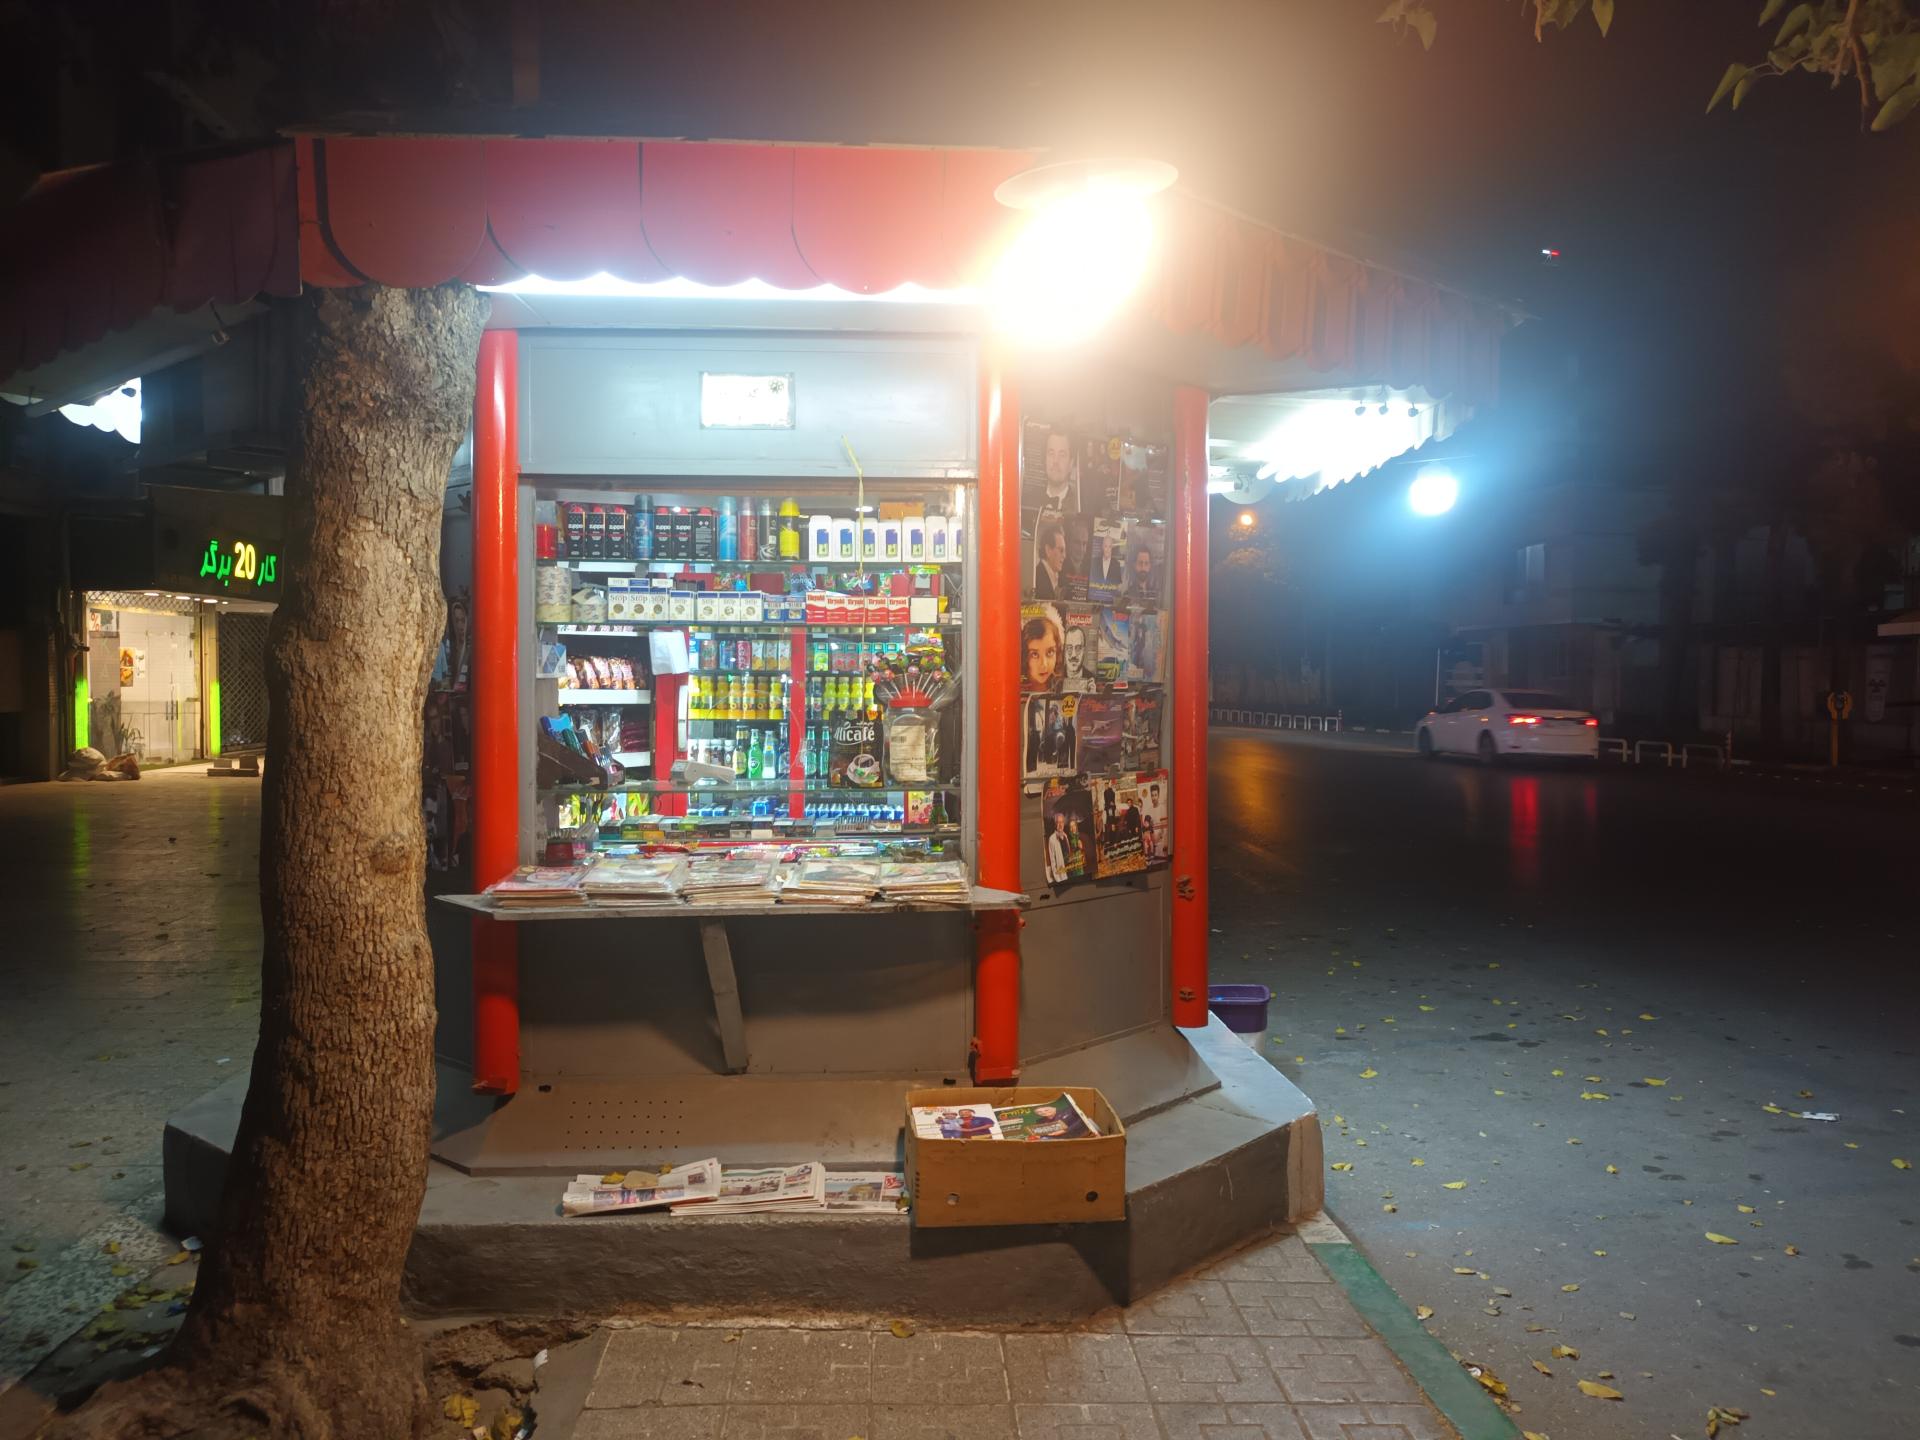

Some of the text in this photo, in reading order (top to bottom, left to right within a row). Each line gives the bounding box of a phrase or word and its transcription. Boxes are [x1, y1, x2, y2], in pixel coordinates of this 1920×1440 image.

[235, 541, 256, 580] 20
[610, 594, 628, 605] Stop
[630, 594, 648, 605] Stop
